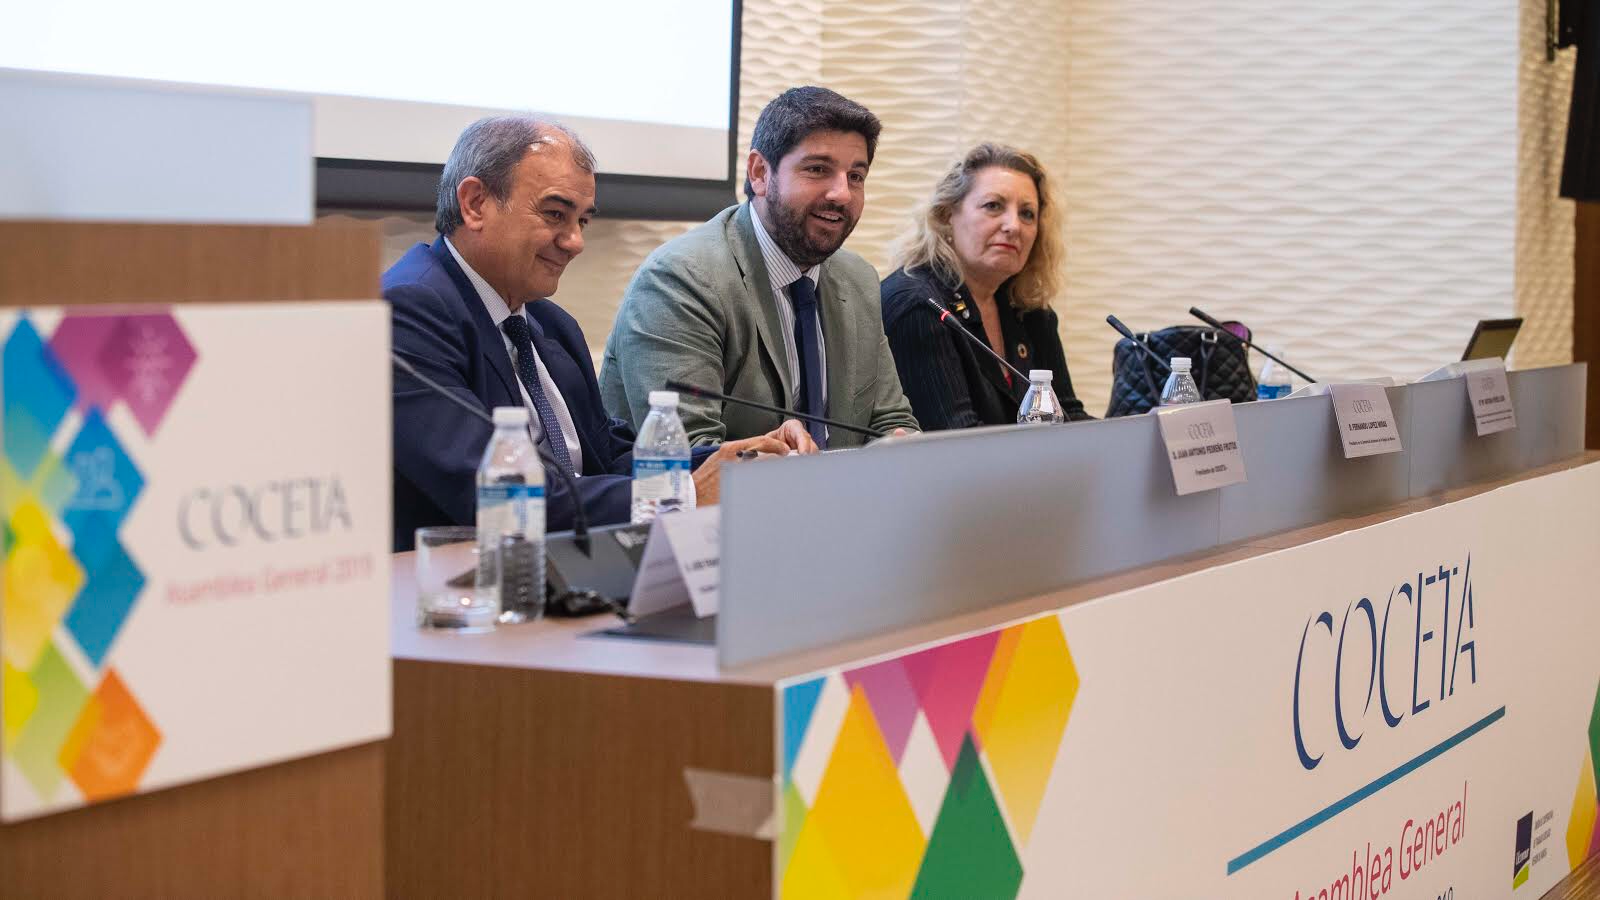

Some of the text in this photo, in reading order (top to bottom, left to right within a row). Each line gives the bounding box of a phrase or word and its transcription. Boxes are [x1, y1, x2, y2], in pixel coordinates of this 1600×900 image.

[1188, 445, 1206, 457] ANTONIO
[176, 476, 353, 552] COCETA
[262, 563, 329, 593] General
[1293, 551, 1476, 771] COCETA
[1294, 780, 1467, 900] mblea General
